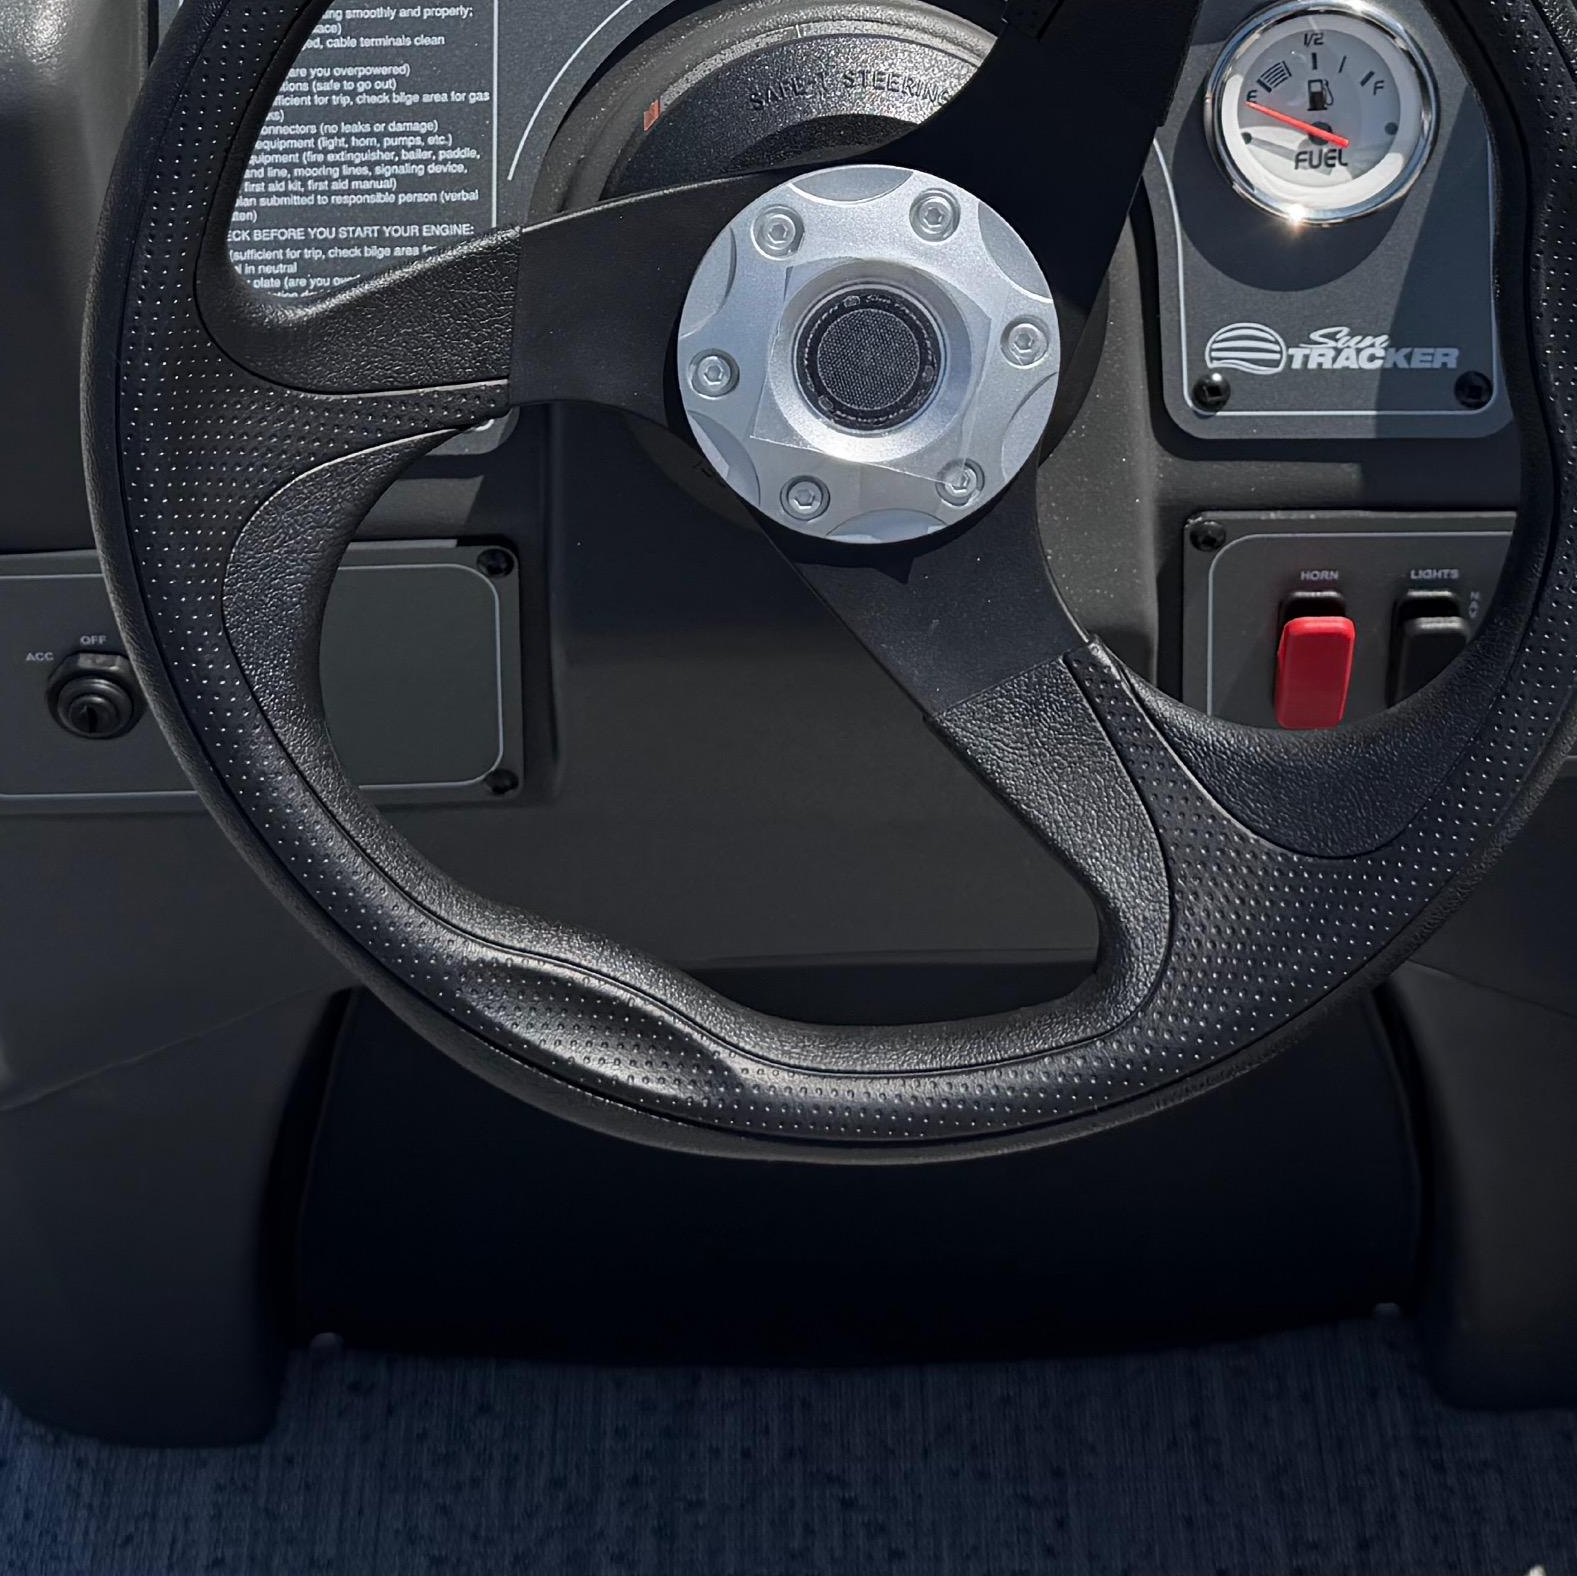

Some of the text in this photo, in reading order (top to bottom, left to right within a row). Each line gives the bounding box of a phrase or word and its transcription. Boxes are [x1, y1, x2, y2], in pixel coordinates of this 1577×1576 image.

[346, 6, 396, 20] smoothly
[399, 6, 421, 17] and
[423, 4, 473, 20] properly;
[326, 36, 356, 48] cable
[360, 34, 411, 47] terminals
[414, 34, 445, 46] clean
[1303, 33, 1324, 47] 1/2
[310, 66, 330, 78] you
[333, 63, 410, 77] overpowered)
[312, 79, 340, 93] (safe
[343, 80, 354, 90] to
[357, 80, 372, 92] go
[374, 78, 397, 91] out)
[841, 69, 950, 106] STEERING
[1373, 79, 1385, 96] F
[314, 94, 330, 105] for
[332, 93, 354, 107] trip,
[356, 93, 390, 105] check
[392, 92, 420, 106] bilge
[422, 93, 448, 103] area
[450, 91, 466, 102] for
[468, 92, 490, 104] gas
[1246, 89, 1258, 103] E
[320, 122, 338, 136] (no
[341, 122, 371, 133] leaks
[373, 123, 385, 132] or
[388, 120, 438, 134] damage)
[318, 136, 348, 149] (light,
[351, 135, 380, 148] horn,
[383, 135, 425, 148] pumps,
[427, 133, 453, 147] etc.)
[302, 150, 324, 164] (fire
[327, 149, 399, 164] extinguisher,
[401, 148, 436, 161] bailer,
[438, 147, 481, 161] paddle,
[1294, 148, 1349, 170] FUEL
[267, 167, 291, 179] line,
[293, 166, 339, 180] mooring
[342, 165, 372, 177] lines,
[374, 164, 424, 178] signaling
[427, 163, 468, 174] device,
[244, 177, 397, 193] first aid kit, first aid manual)
[259, 194, 315, 206] submitted
[317, 195, 329, 205] to
[331, 192, 395, 206] responsible
[398, 192, 438, 204] person
[440, 190, 479, 204] (verbal
[253, 228, 306, 241] BEFORE
[308, 227, 336, 240] YOU
[339, 225, 380, 238] START
[383, 225, 419, 238] YOUR
[423, 224, 474, 237] ENGINE:
[229, 247, 284, 262] (sufficient
[286, 248, 301, 259] for
[304, 248, 325, 261] trip,
[328, 246, 362, 258] check
[364, 245, 391, 259] bilge
[393, 246, 419, 256] area
[245, 263, 255, 274] in
[258, 262, 298, 274] neutral
[283, 276, 307, 290] (are
[309, 276, 330, 289] you
[1299, 326, 1391, 349] Sun
[1288, 347, 1460, 369] TRACKER
[1300, 570, 1339, 581] HORN
[1410, 569, 1460, 580] LIGHTS
[80, 635, 107, 645] OFF
[26, 652, 54, 662] ACC
